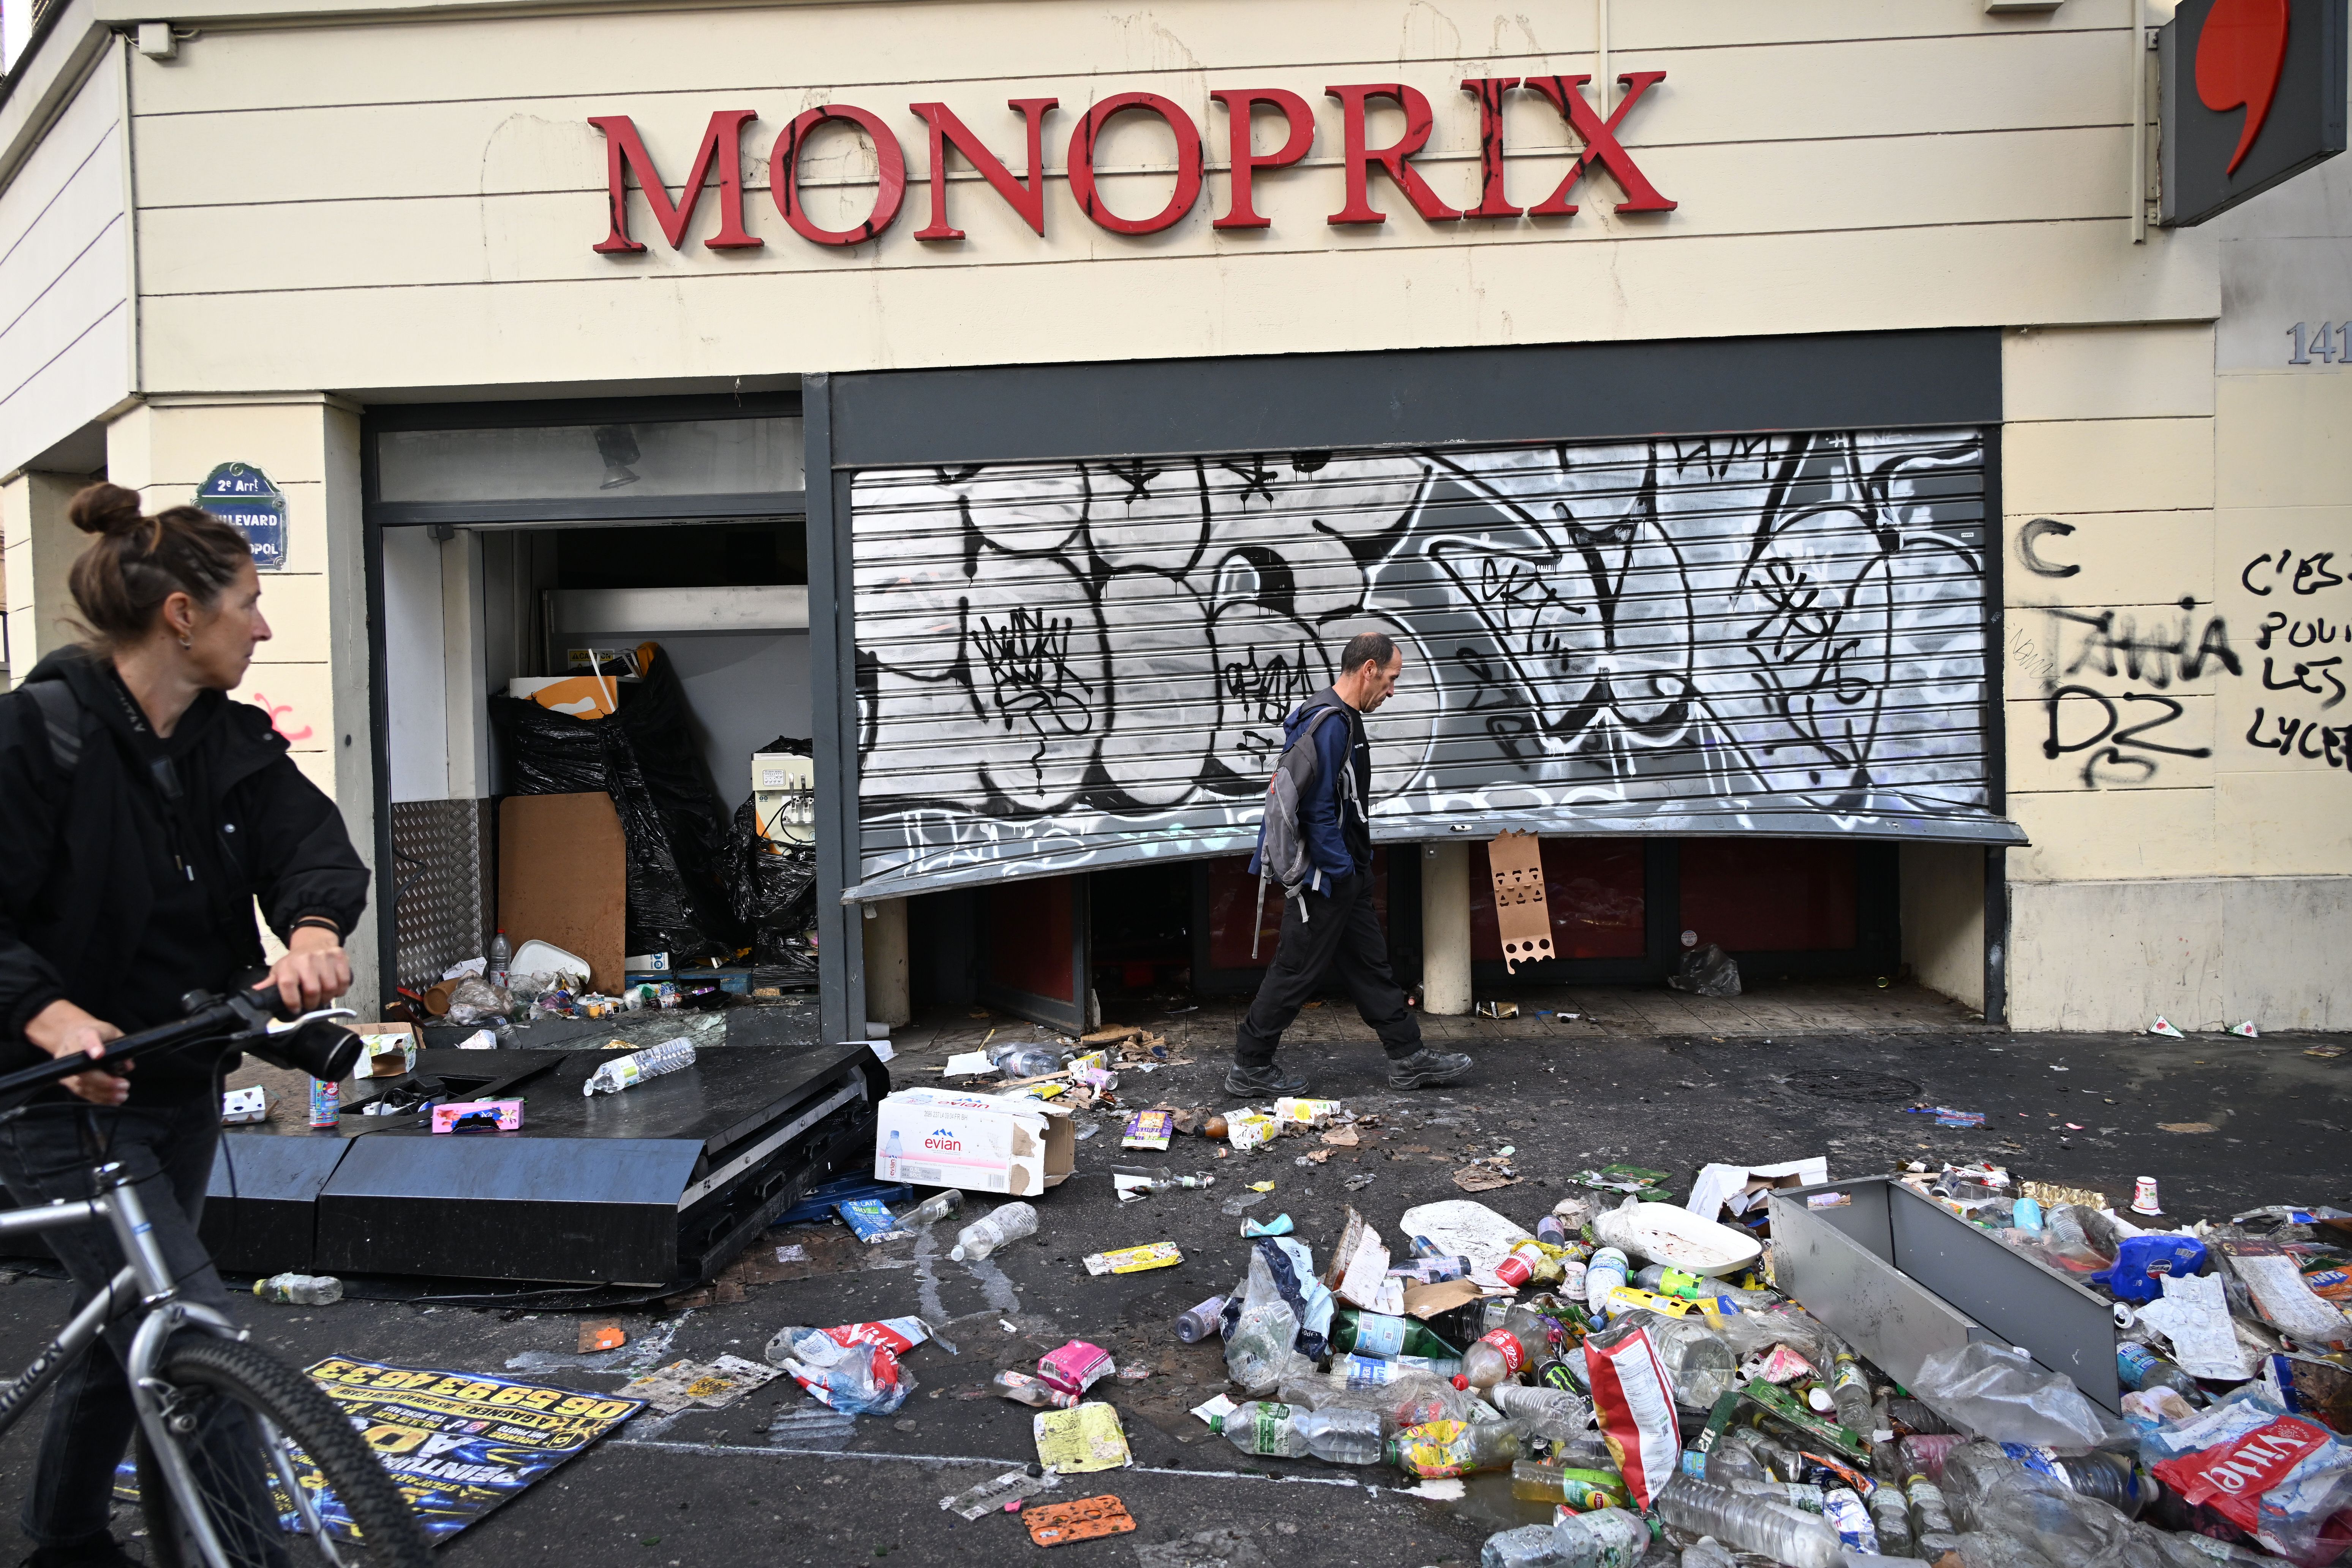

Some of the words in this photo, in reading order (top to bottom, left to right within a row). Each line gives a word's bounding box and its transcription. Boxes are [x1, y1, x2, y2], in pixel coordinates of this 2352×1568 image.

[587, 71, 1678, 250] MONOPRIX
[2242, 549, 2352, 596] C'ES
[1292, 851, 1302, 872] Quechua
[925, 1138, 961, 1151] evian
[1724, 1300, 1735, 1312] FLYING
[312, 1361, 382, 1384] 33
[369, 1370, 441, 1390] 46
[426, 1377, 501, 1399] 93
[488, 1386, 563, 1409] 59
[552, 1396, 631, 1419] 06
[487, 1430, 537, 1445] PRENDS
[496, 1425, 530, 1436] PHOTO
[527, 1430, 550, 1438] UNE
[376, 1450, 534, 1484] PEINTUR
[2198, 1433, 2309, 1494] Vittel
